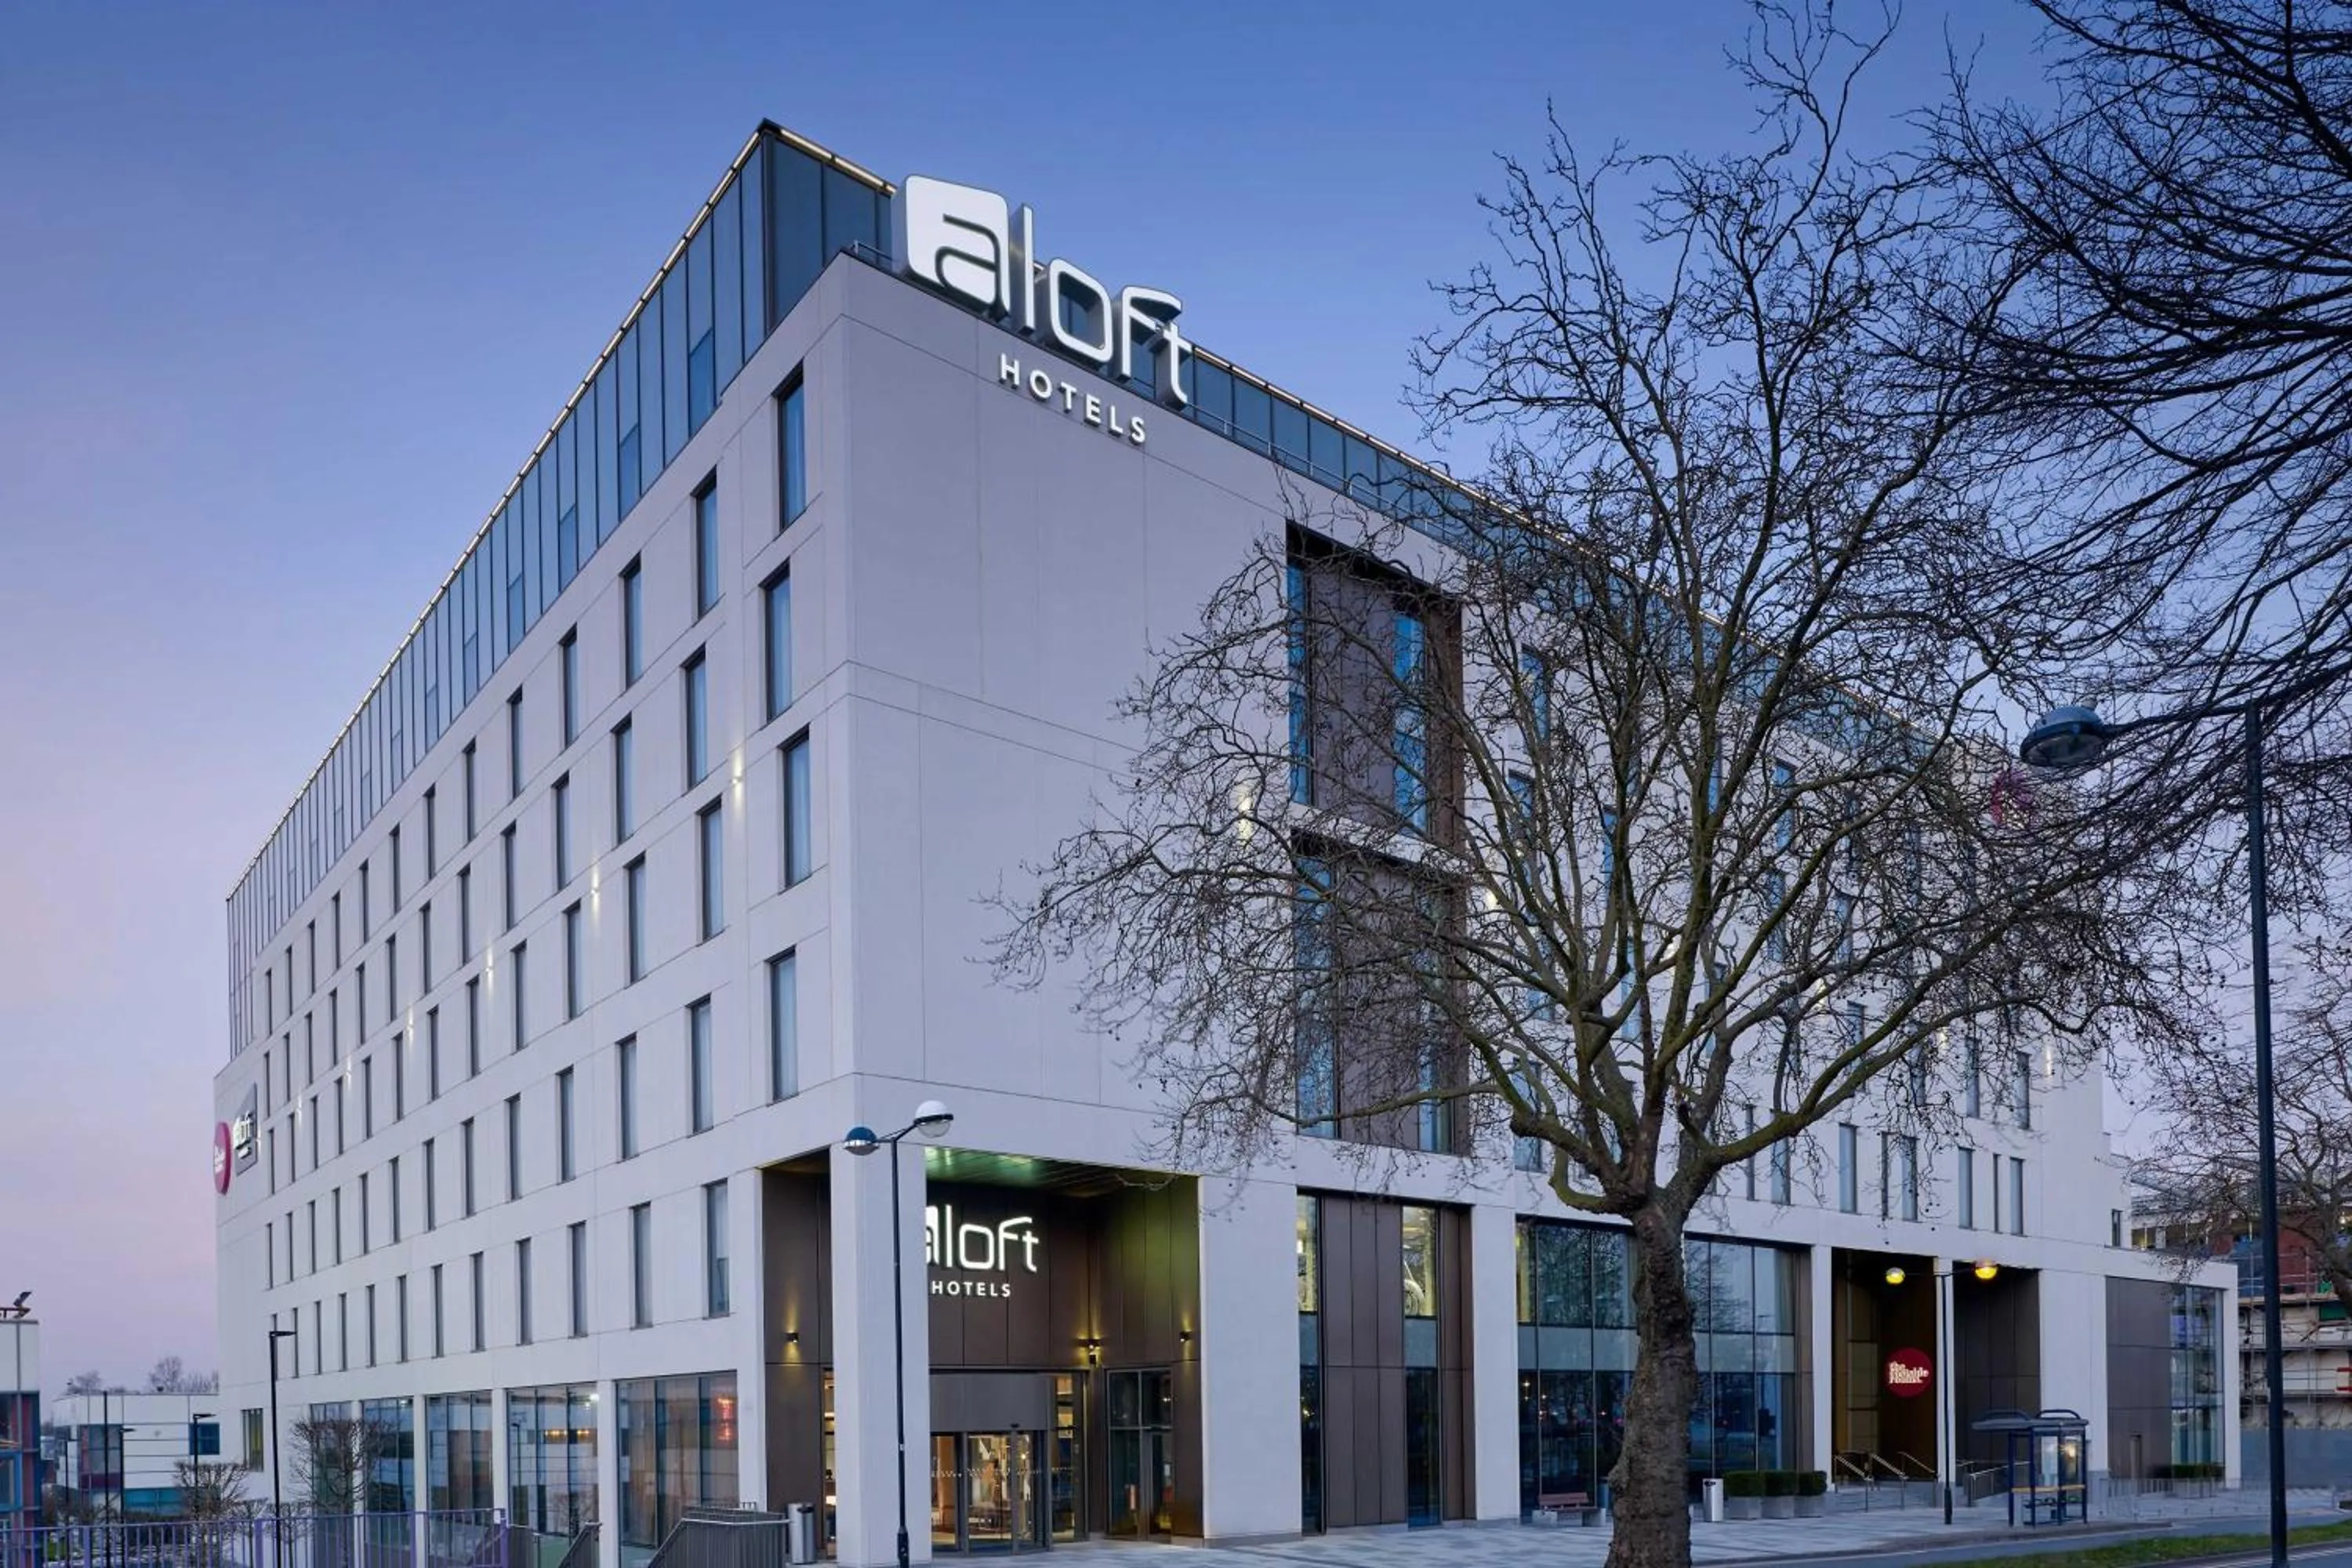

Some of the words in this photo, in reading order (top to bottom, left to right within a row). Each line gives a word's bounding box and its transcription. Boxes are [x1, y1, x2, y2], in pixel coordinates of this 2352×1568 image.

[904, 174, 1193, 405] aloft
[998, 353, 1146, 445] HOTELS
[925, 1204, 1039, 1273] loft
[931, 1280, 1011, 1298] HOTELS
